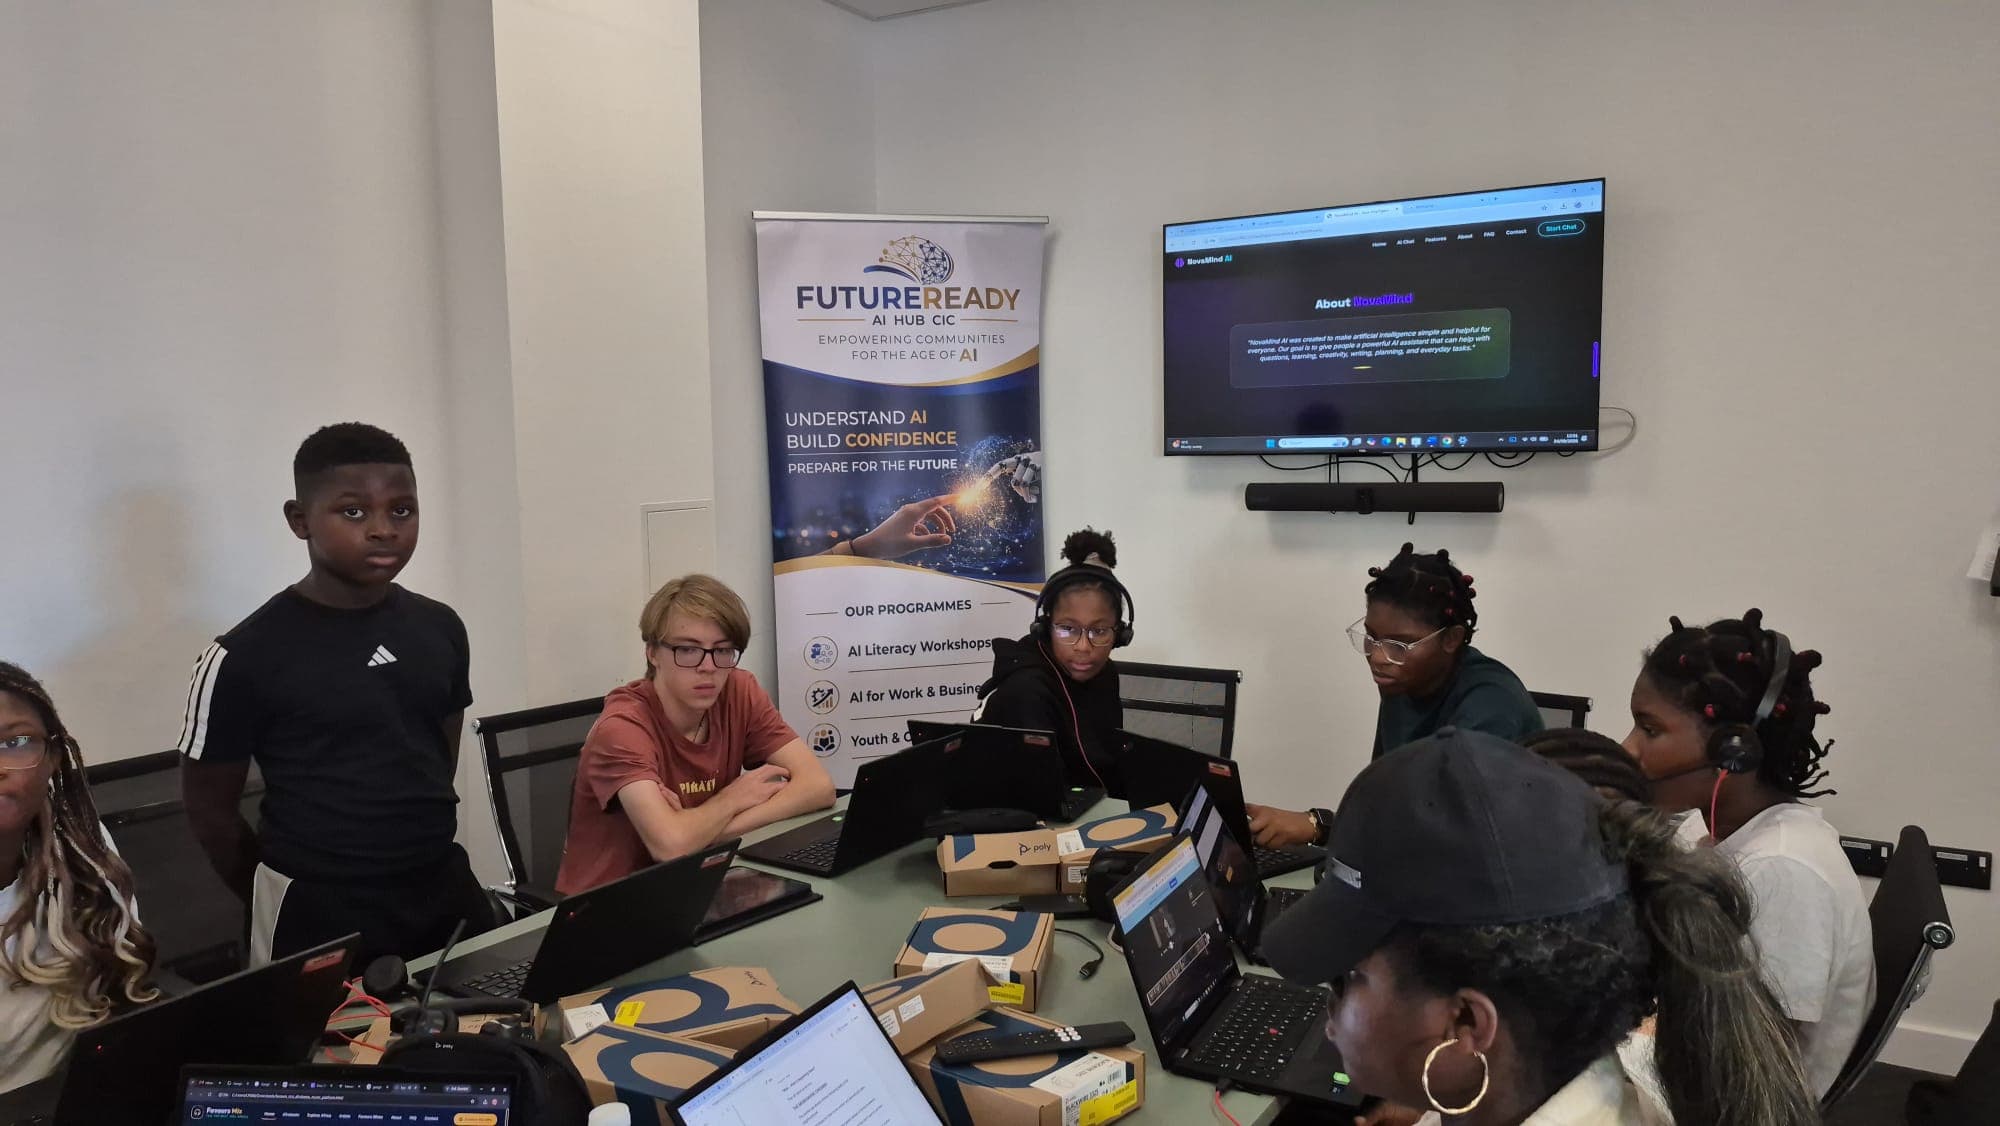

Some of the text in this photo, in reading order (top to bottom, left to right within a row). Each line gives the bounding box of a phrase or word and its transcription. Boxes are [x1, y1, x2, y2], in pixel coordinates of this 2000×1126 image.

[1506, 228, 1528, 236] Contact
[1546, 224, 1560, 232] Start
[1562, 224, 1577, 232] Chat
[1187, 255, 1232, 266] NovaMind AI
[797, 286, 1020, 310] FUTUREREADY
[1315, 293, 1414, 310] About NovaMind
[872, 315, 956, 326] AI HUB CIC
[818, 334, 1005, 345] EMPOWERING COMMUNITIES
[1379, 331, 1416, 339] intelligence
[852, 348, 978, 362] FOR THE AGE OF AI
[1248, 347, 1276, 355] everyone.
[1290, 345, 1304, 353] goal
[1362, 340, 1392, 348] powerful
[1260, 354, 1290, 362] questions,
[1318, 351, 1348, 359] creativity,
[1375, 348, 1404, 356] planning,
[1420, 346, 1452, 354] everyday
[786, 410, 928, 426] UNDERSTAND AI
[787, 432, 957, 449] BUILD CONFIDENCE
[788, 458, 958, 474] PREPARE FOR THE FUTURE
[845, 600, 972, 617] OUR PROGRAMMES
[848, 637, 992, 657] AI Literacy Workshops
[850, 692, 863, 703] AI
[866, 690, 885, 702] for
[888, 687, 923, 700] Work
[927, 686, 936, 698] &
[851, 732, 888, 746] Youth
[892, 732, 900, 743] &
[1034, 842, 1052, 853] poly
